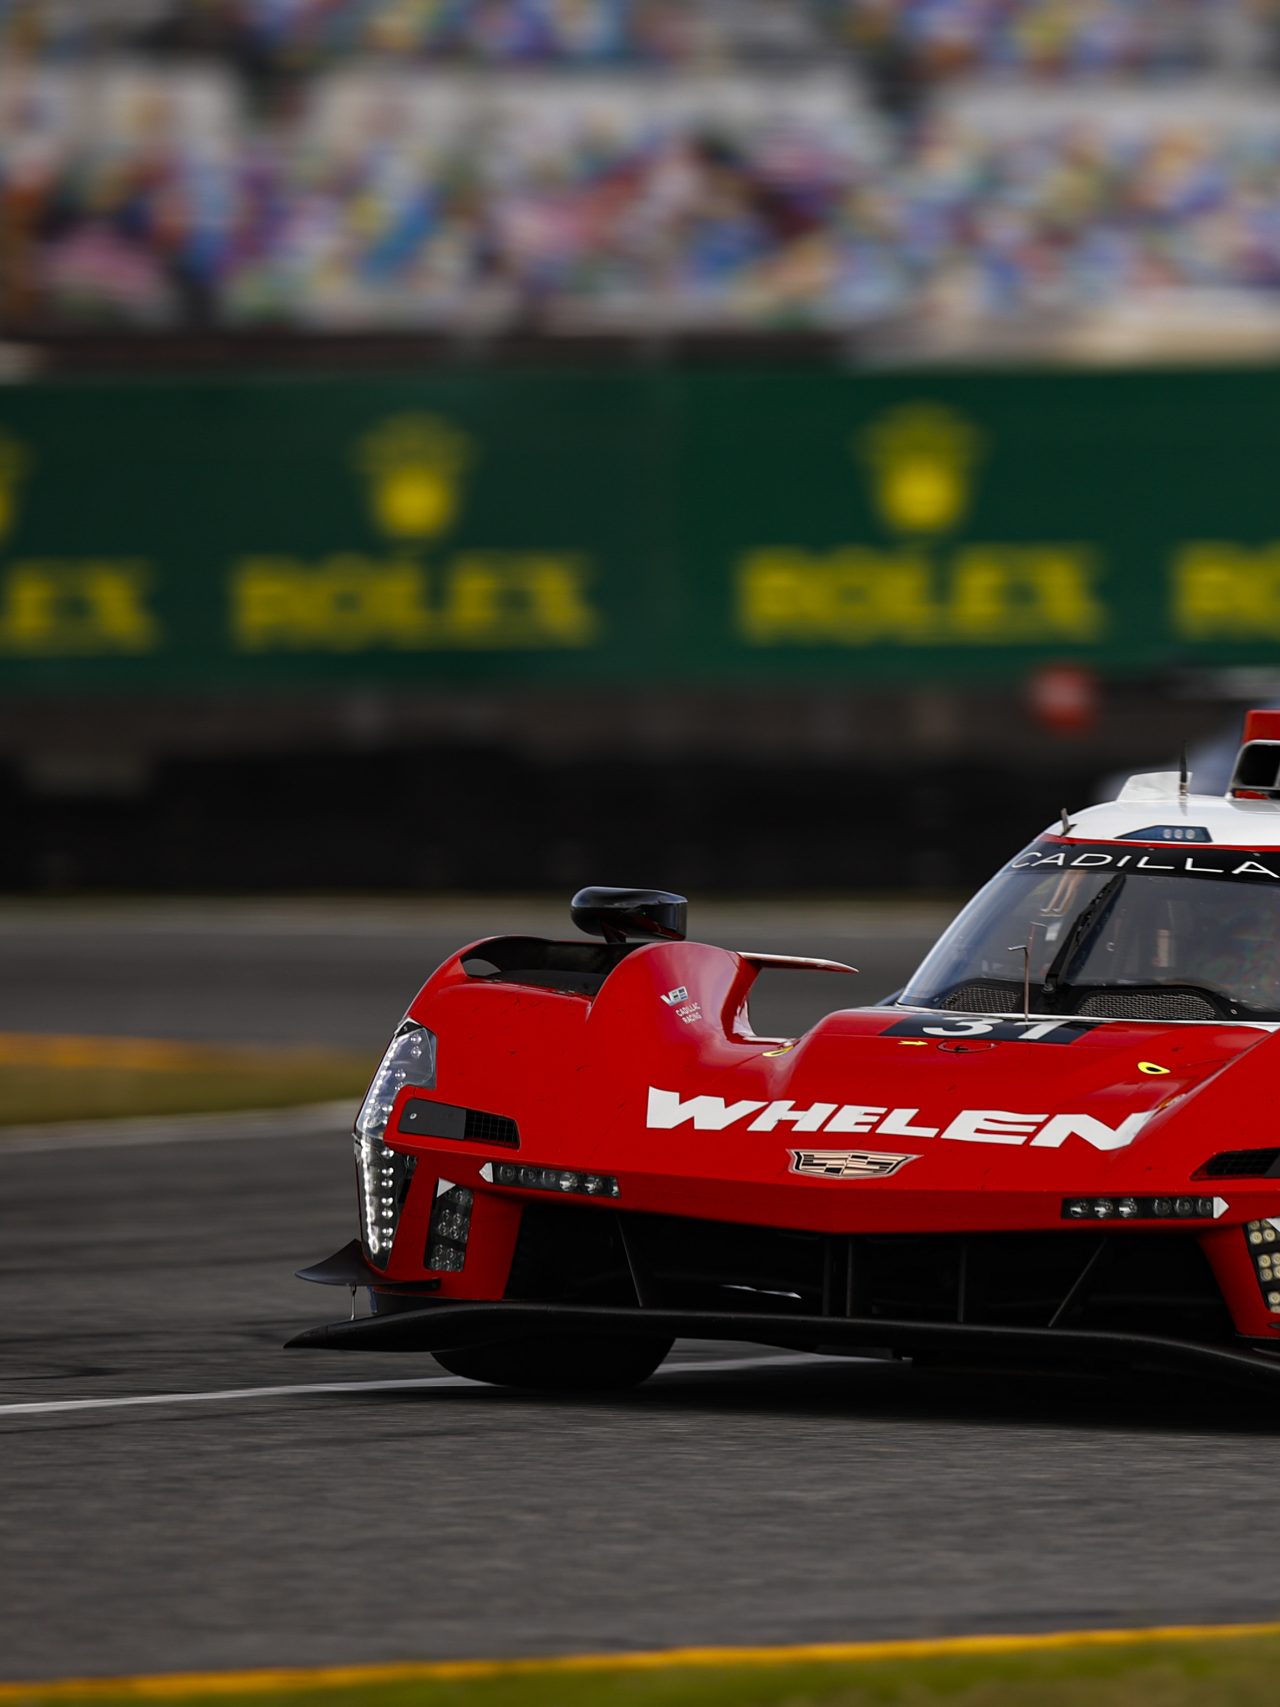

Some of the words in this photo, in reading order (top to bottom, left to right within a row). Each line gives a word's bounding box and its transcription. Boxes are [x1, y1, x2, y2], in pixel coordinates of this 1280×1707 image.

[233, 548, 598, 652] ROLEX
[738, 545, 1102, 644] ROLEX
[923, 1016, 1071, 1041] 31
[646, 1085, 1156, 1150] WHELEN
